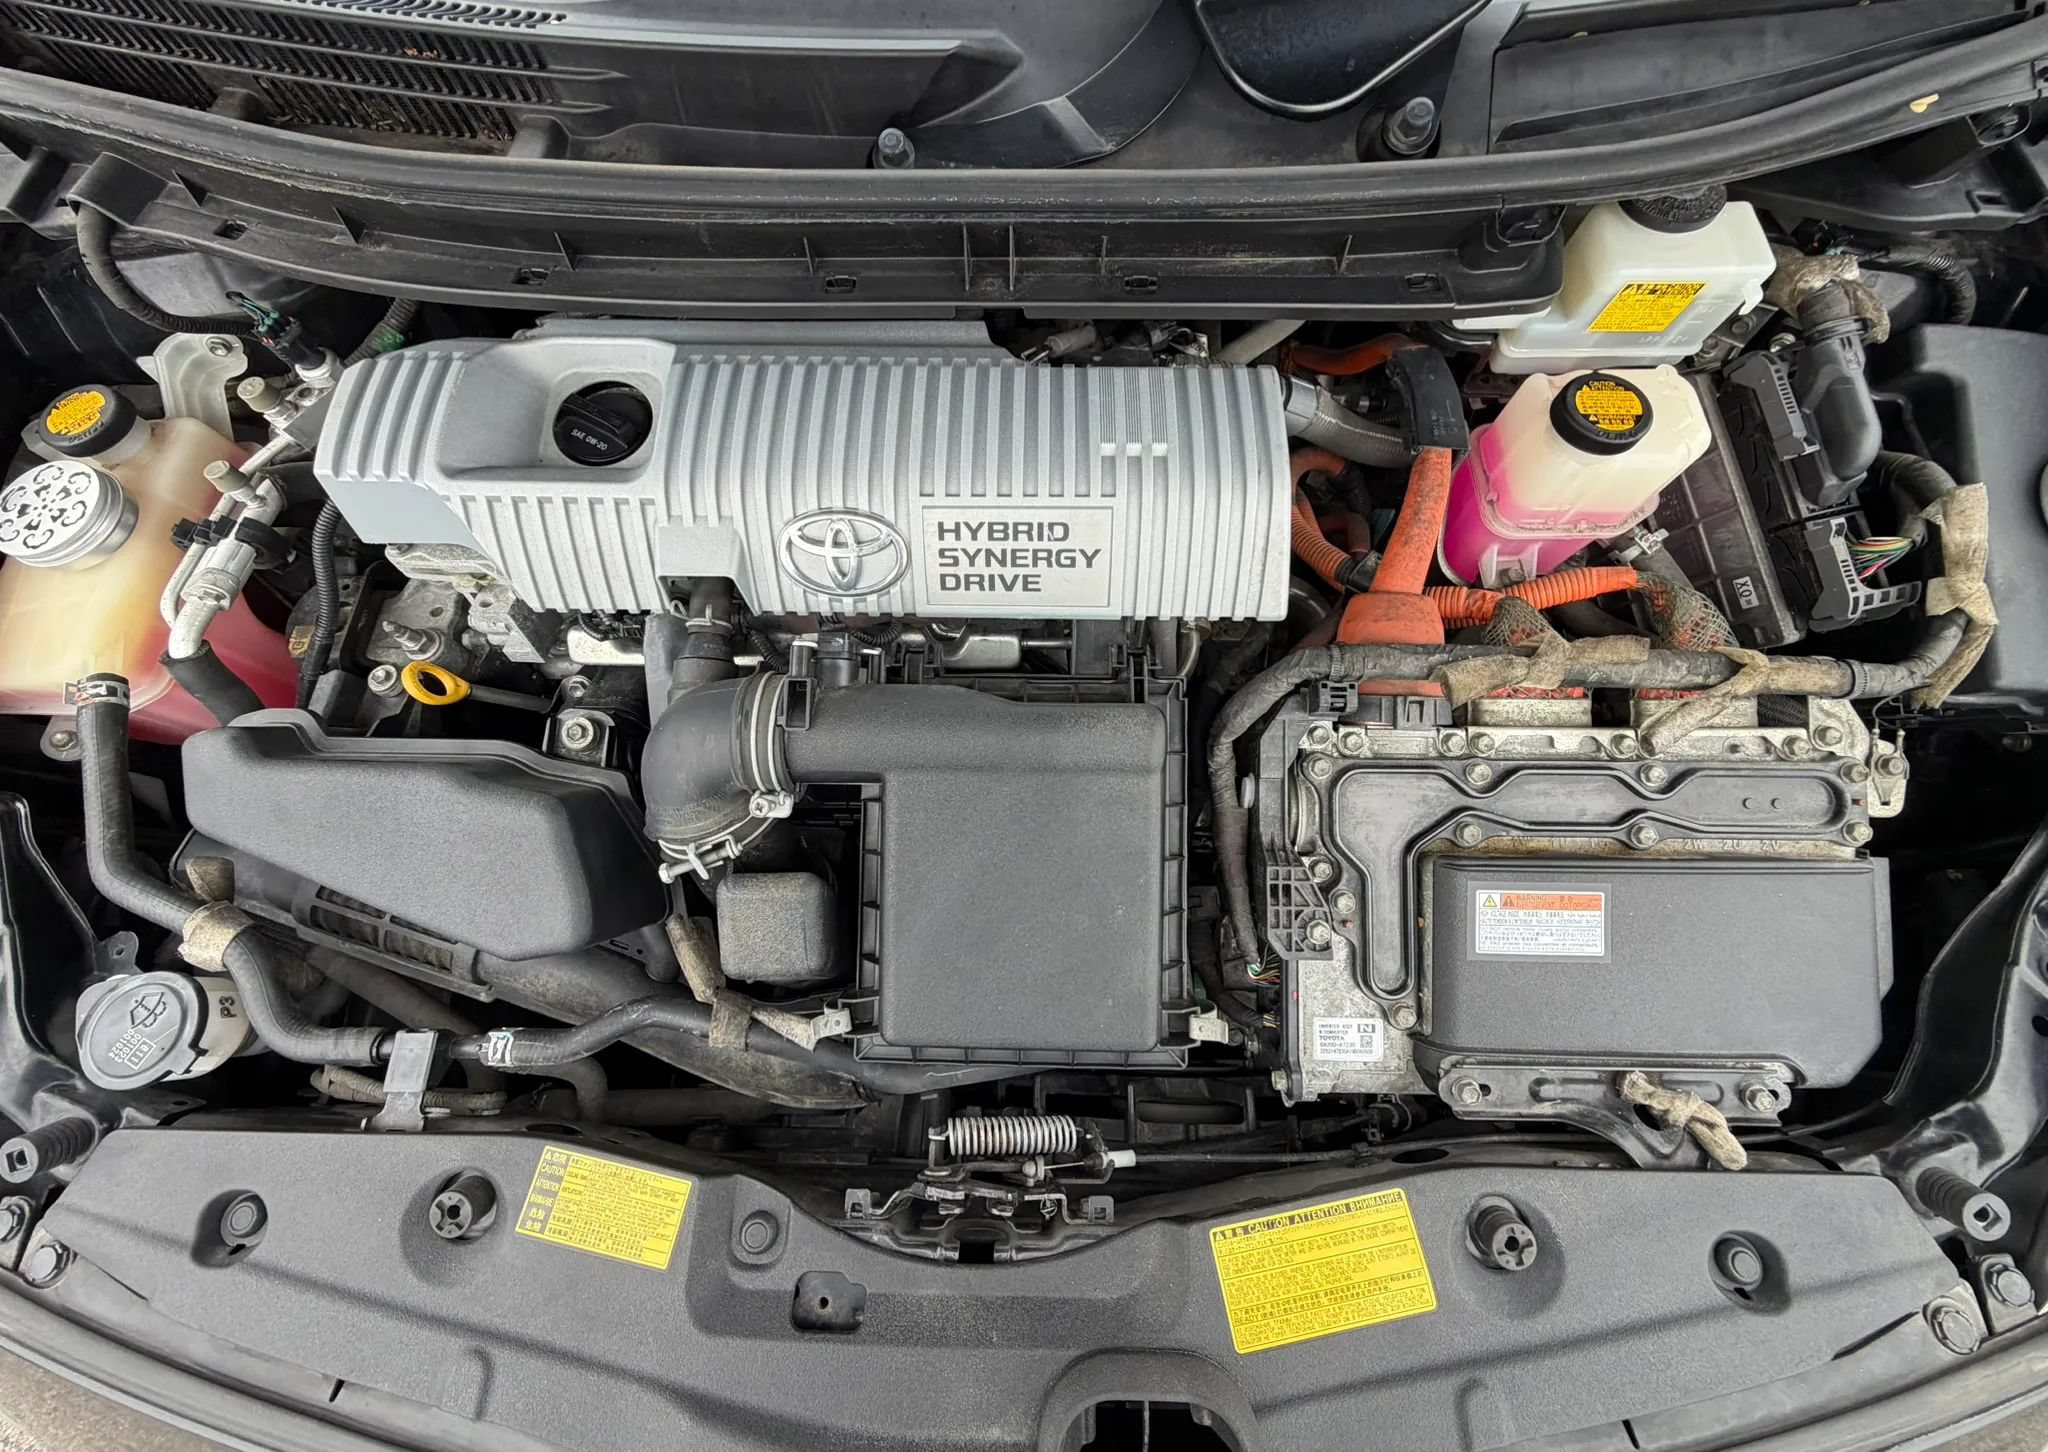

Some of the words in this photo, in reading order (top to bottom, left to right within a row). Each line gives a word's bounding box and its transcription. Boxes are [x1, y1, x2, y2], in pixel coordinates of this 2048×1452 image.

[571, 428, 586, 440] SAE
[585, 435, 608, 451] 0W-20
[937, 521, 1070, 542] HYBRID
[938, 547, 1102, 569] SYNERGY
[939, 573, 1042, 592] DRIVE
[1722, 839, 1742, 850] 2U
[218, 996, 238, 1019] P3
[108, 1028, 135, 1058] 001024
[114, 1033, 142, 1063] 001023
[540, 1162, 566, 1177] CAUTION
[535, 1178, 560, 1192] ATTENTION
[1248, 1217, 1290, 1234] CAUTION
[1294, 1205, 1347, 1224] ATTENTION
[1350, 1192, 1402, 1212] ВНИМАНИЕ
[1234, 1313, 1259, 1326] READY
